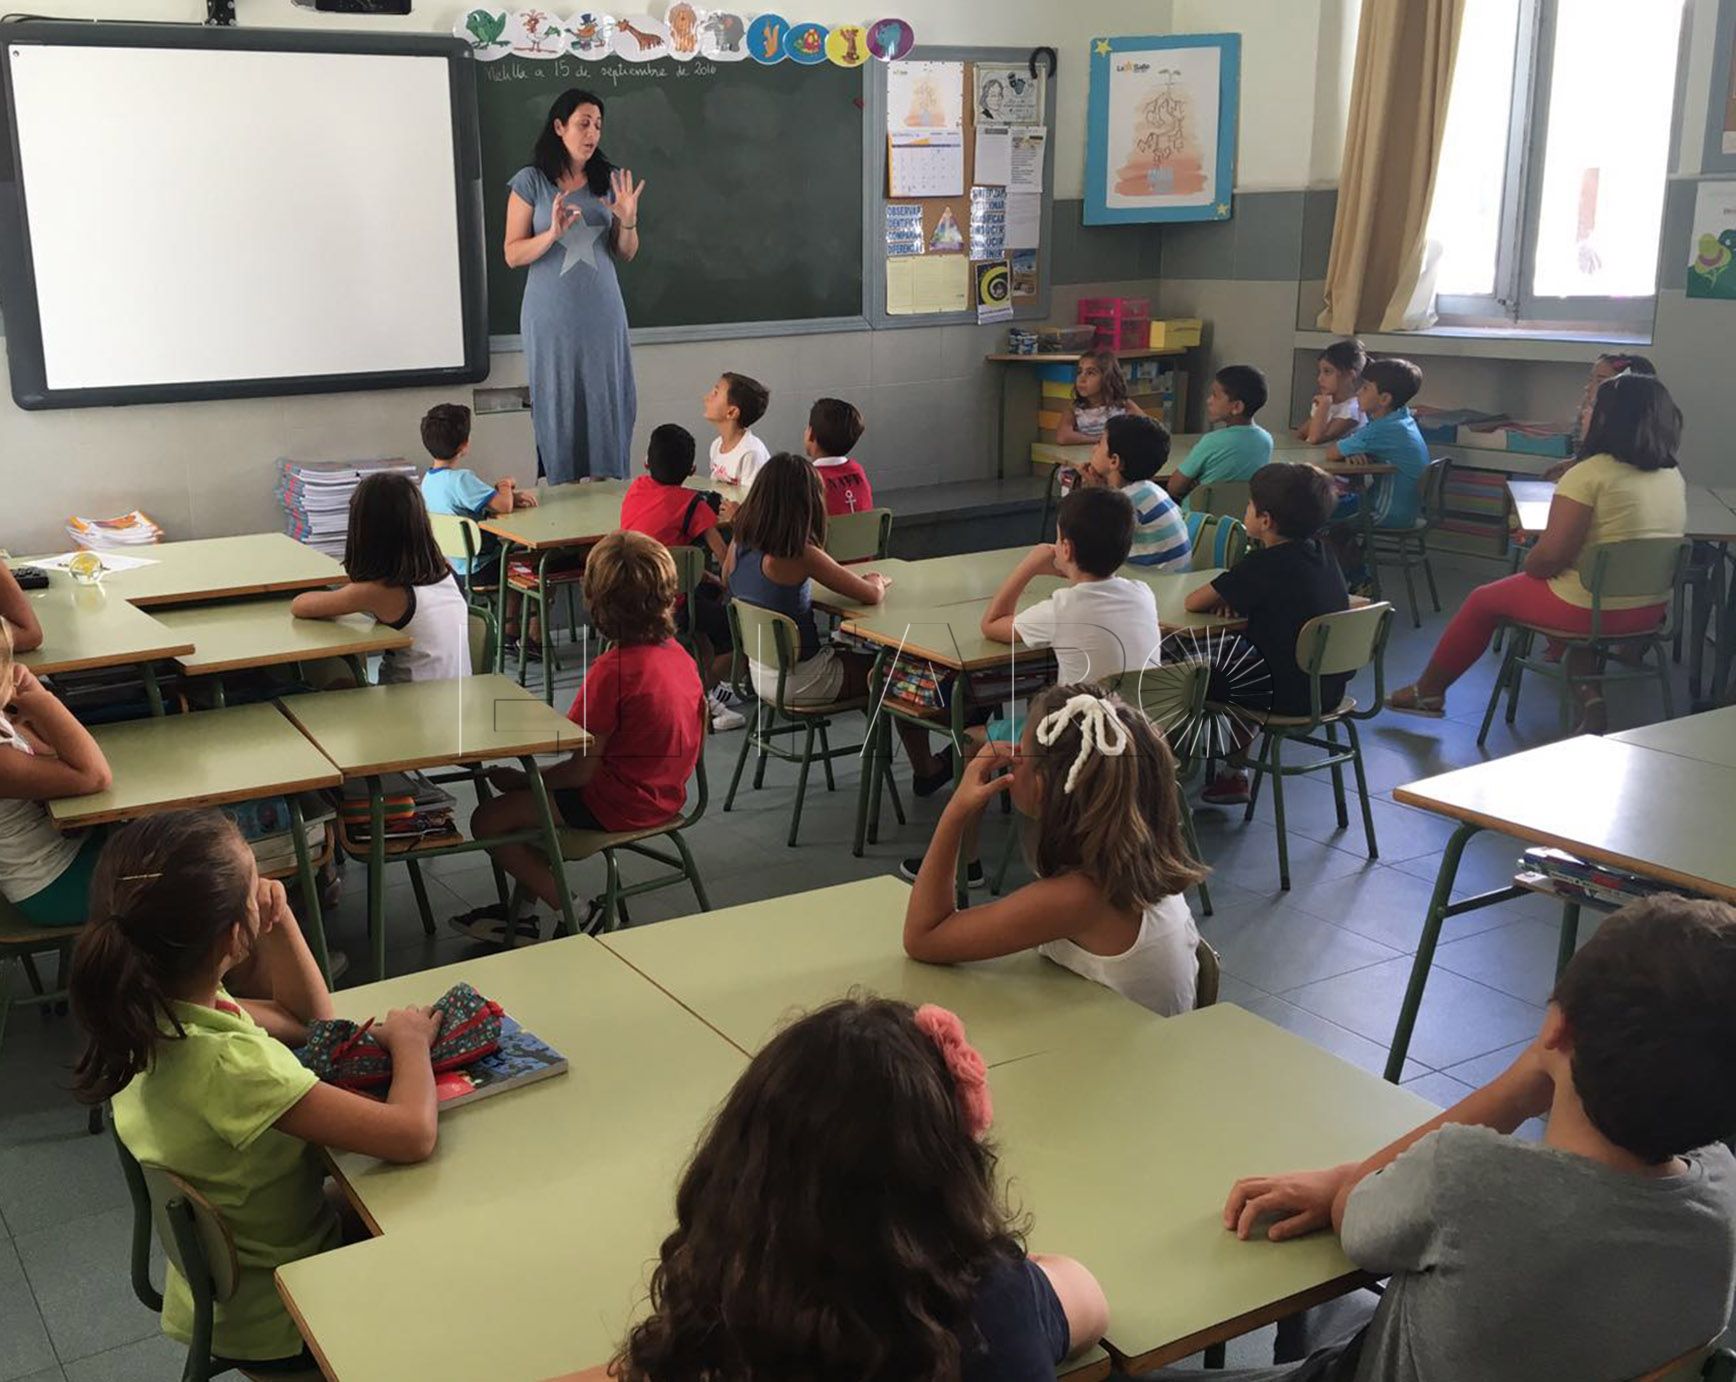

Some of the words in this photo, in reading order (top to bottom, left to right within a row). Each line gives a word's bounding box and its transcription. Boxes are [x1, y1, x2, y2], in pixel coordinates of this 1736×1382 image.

[534, 68, 545, 78] a
[554, 60, 570, 77] 15
[600, 63, 668, 86] septiembre
